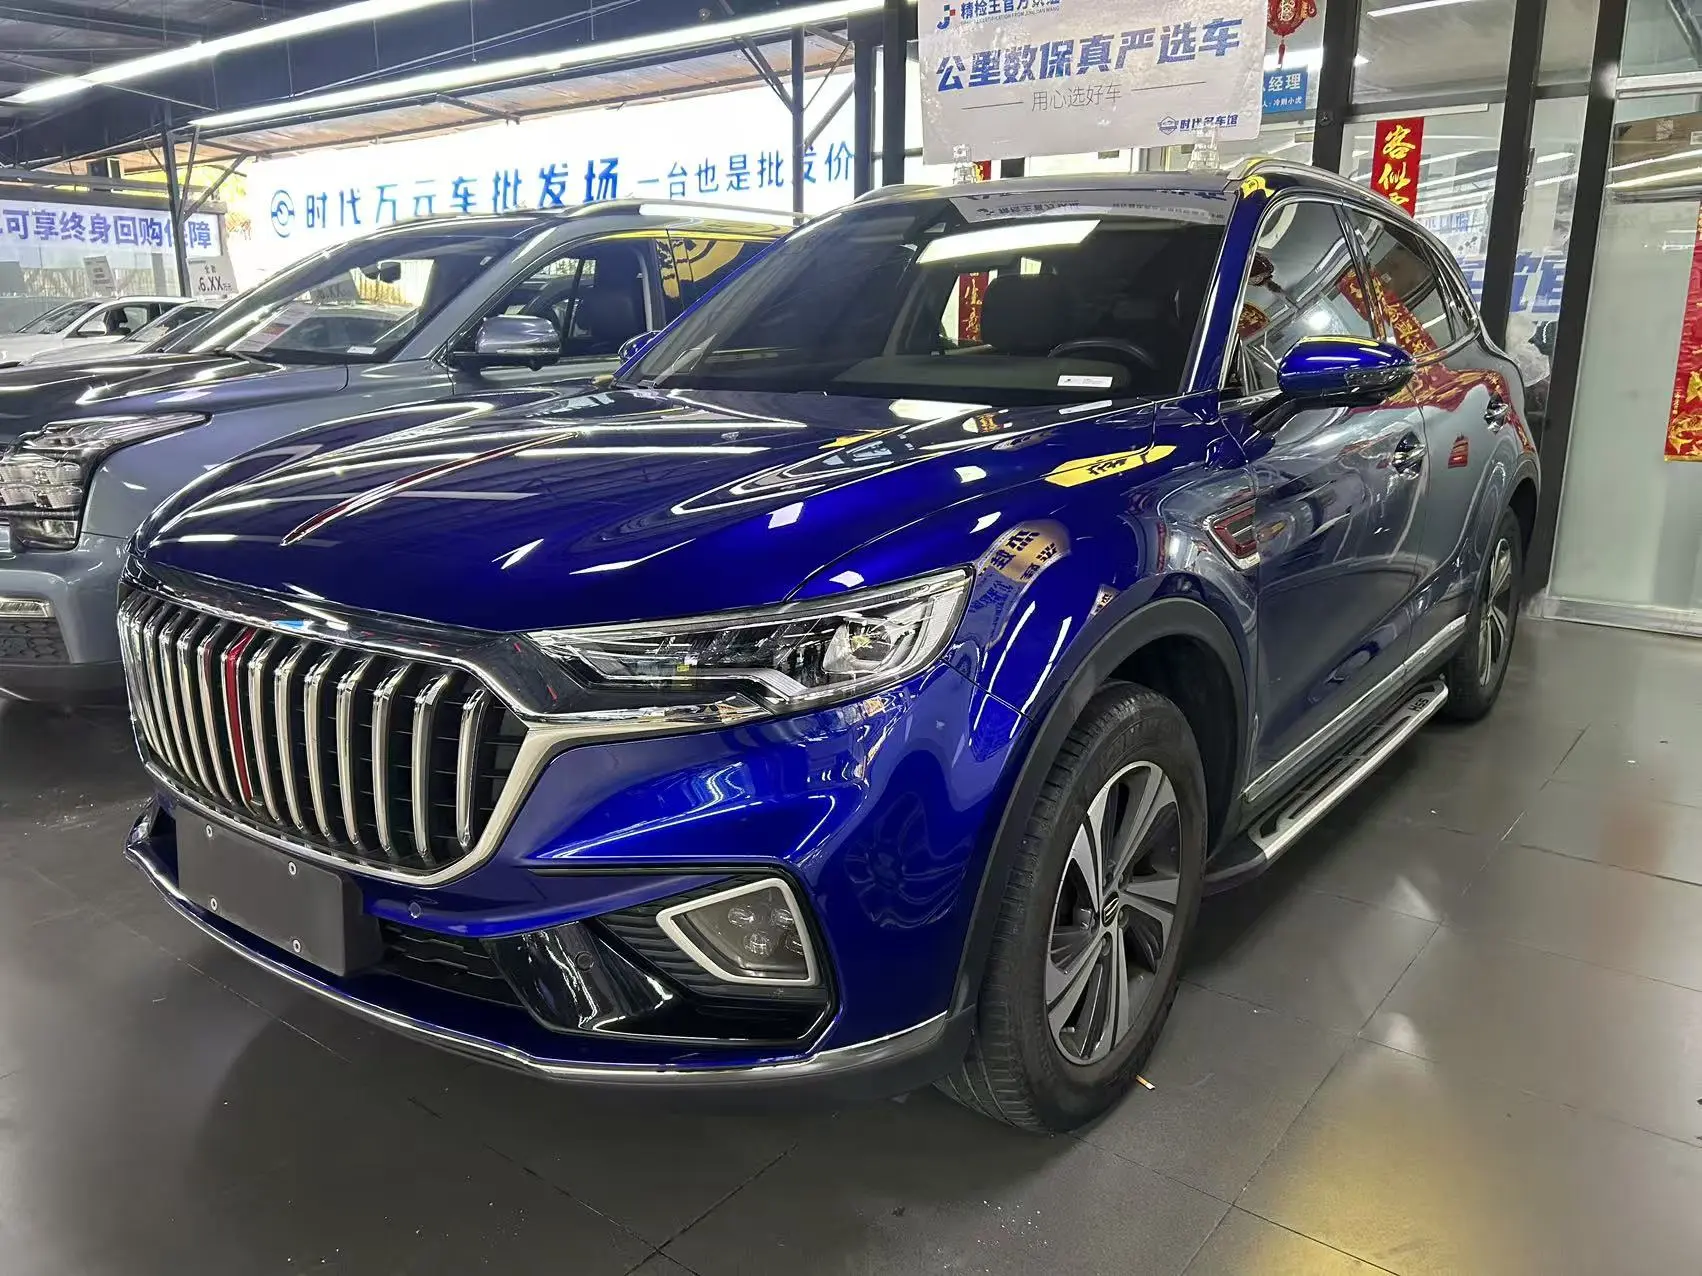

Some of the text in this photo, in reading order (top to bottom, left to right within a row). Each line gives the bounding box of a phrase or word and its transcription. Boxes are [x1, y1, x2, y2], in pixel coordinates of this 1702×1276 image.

[936, 17, 1243, 92] 公里数保真严选车
[1031, 83, 1123, 112] 用心选好车
[306, 157, 618, 229] 时代万元车批发场
